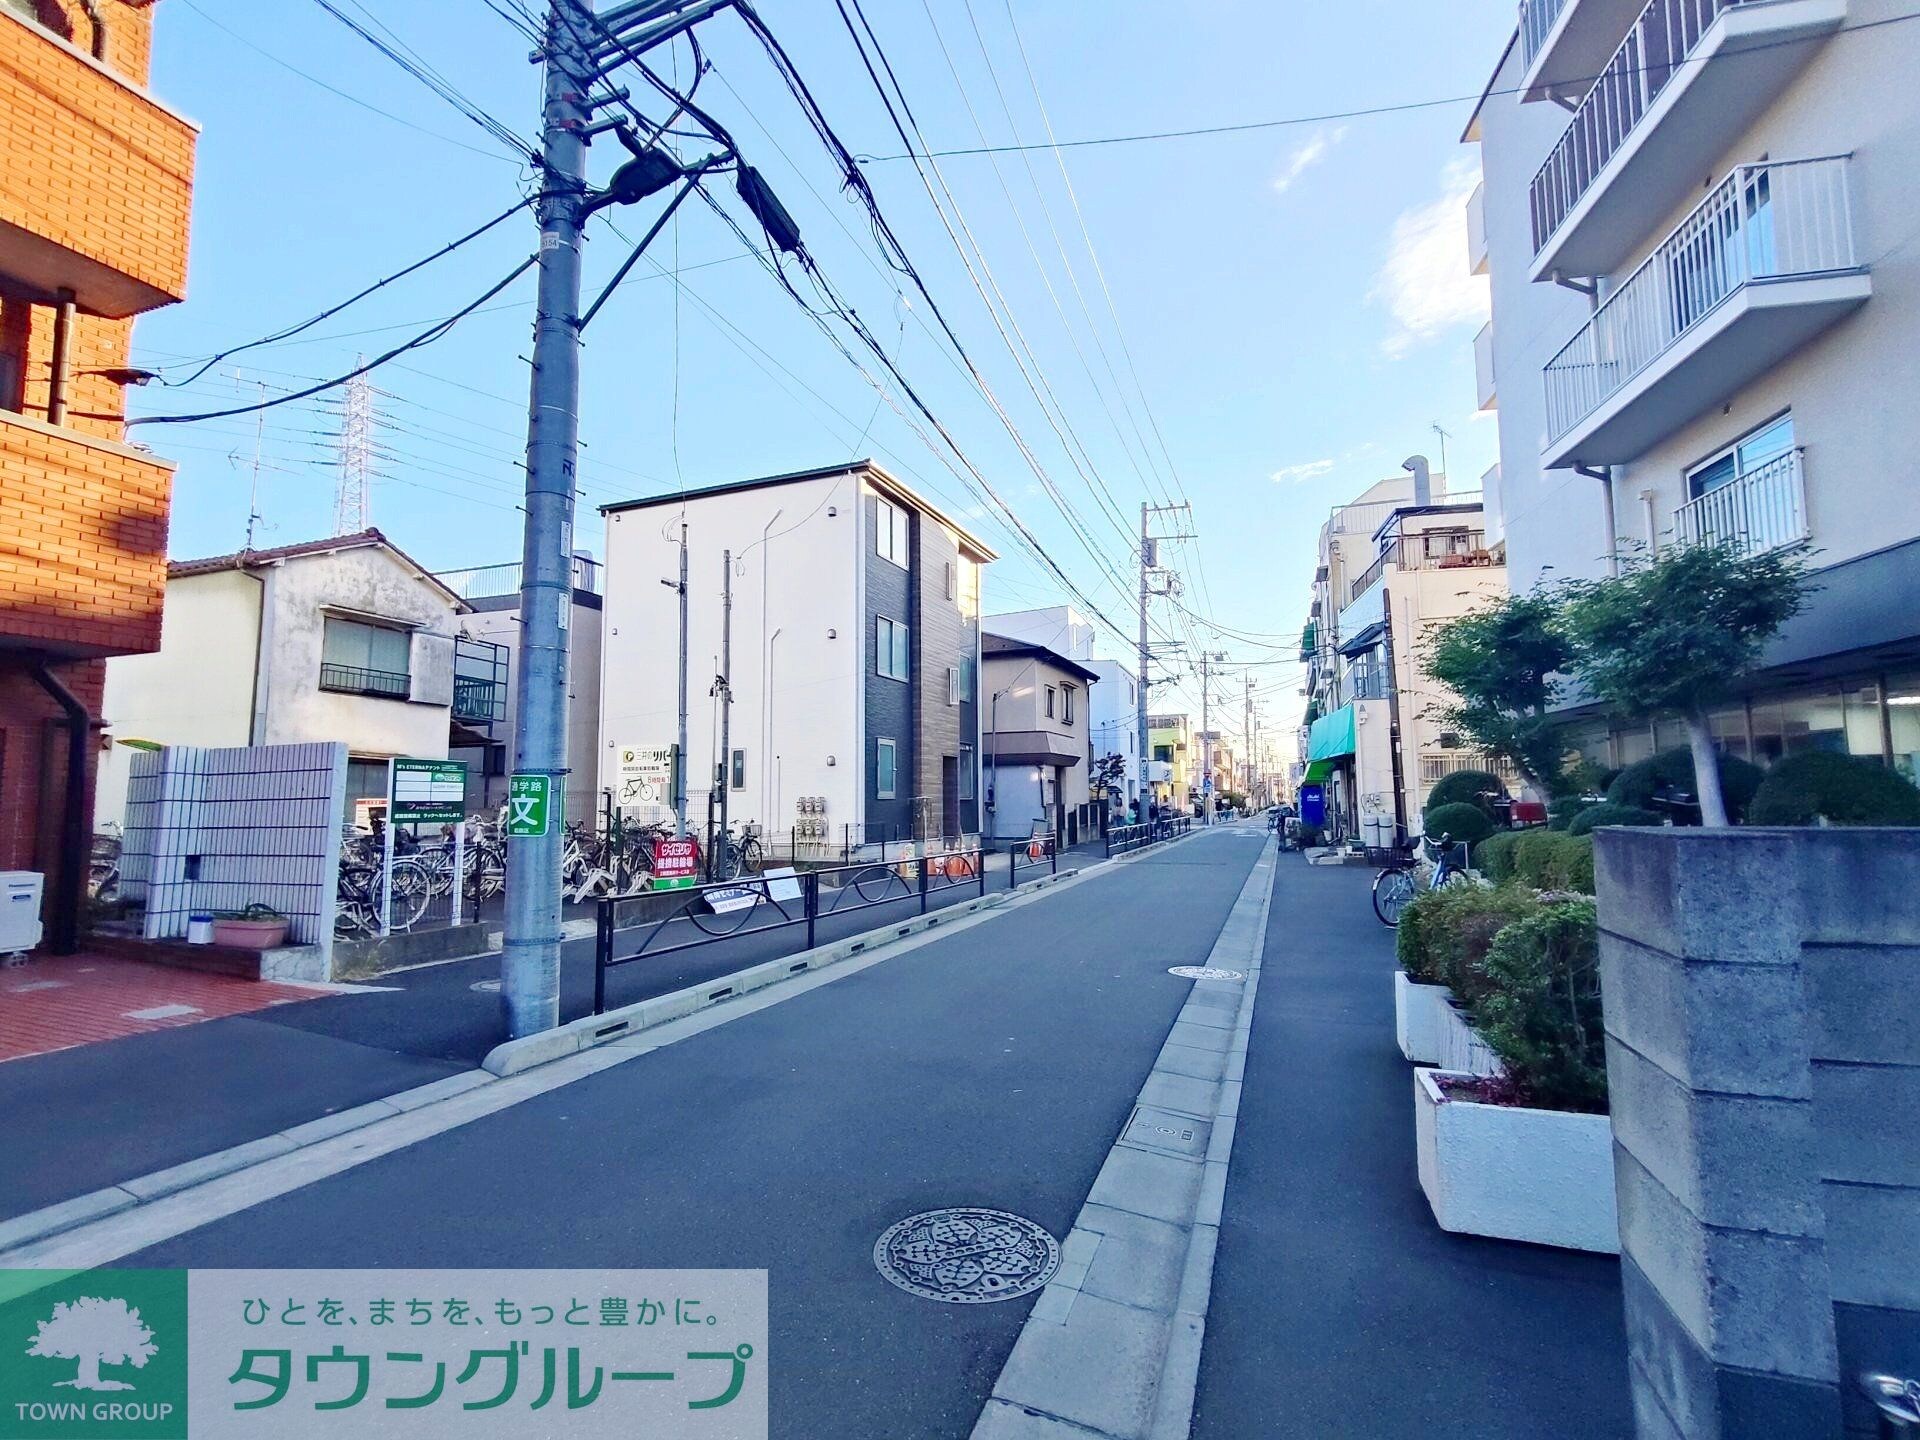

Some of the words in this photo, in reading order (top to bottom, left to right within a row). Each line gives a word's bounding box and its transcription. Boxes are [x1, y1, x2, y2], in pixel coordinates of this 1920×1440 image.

[661, 843, 692, 857] サイゼリヤ
